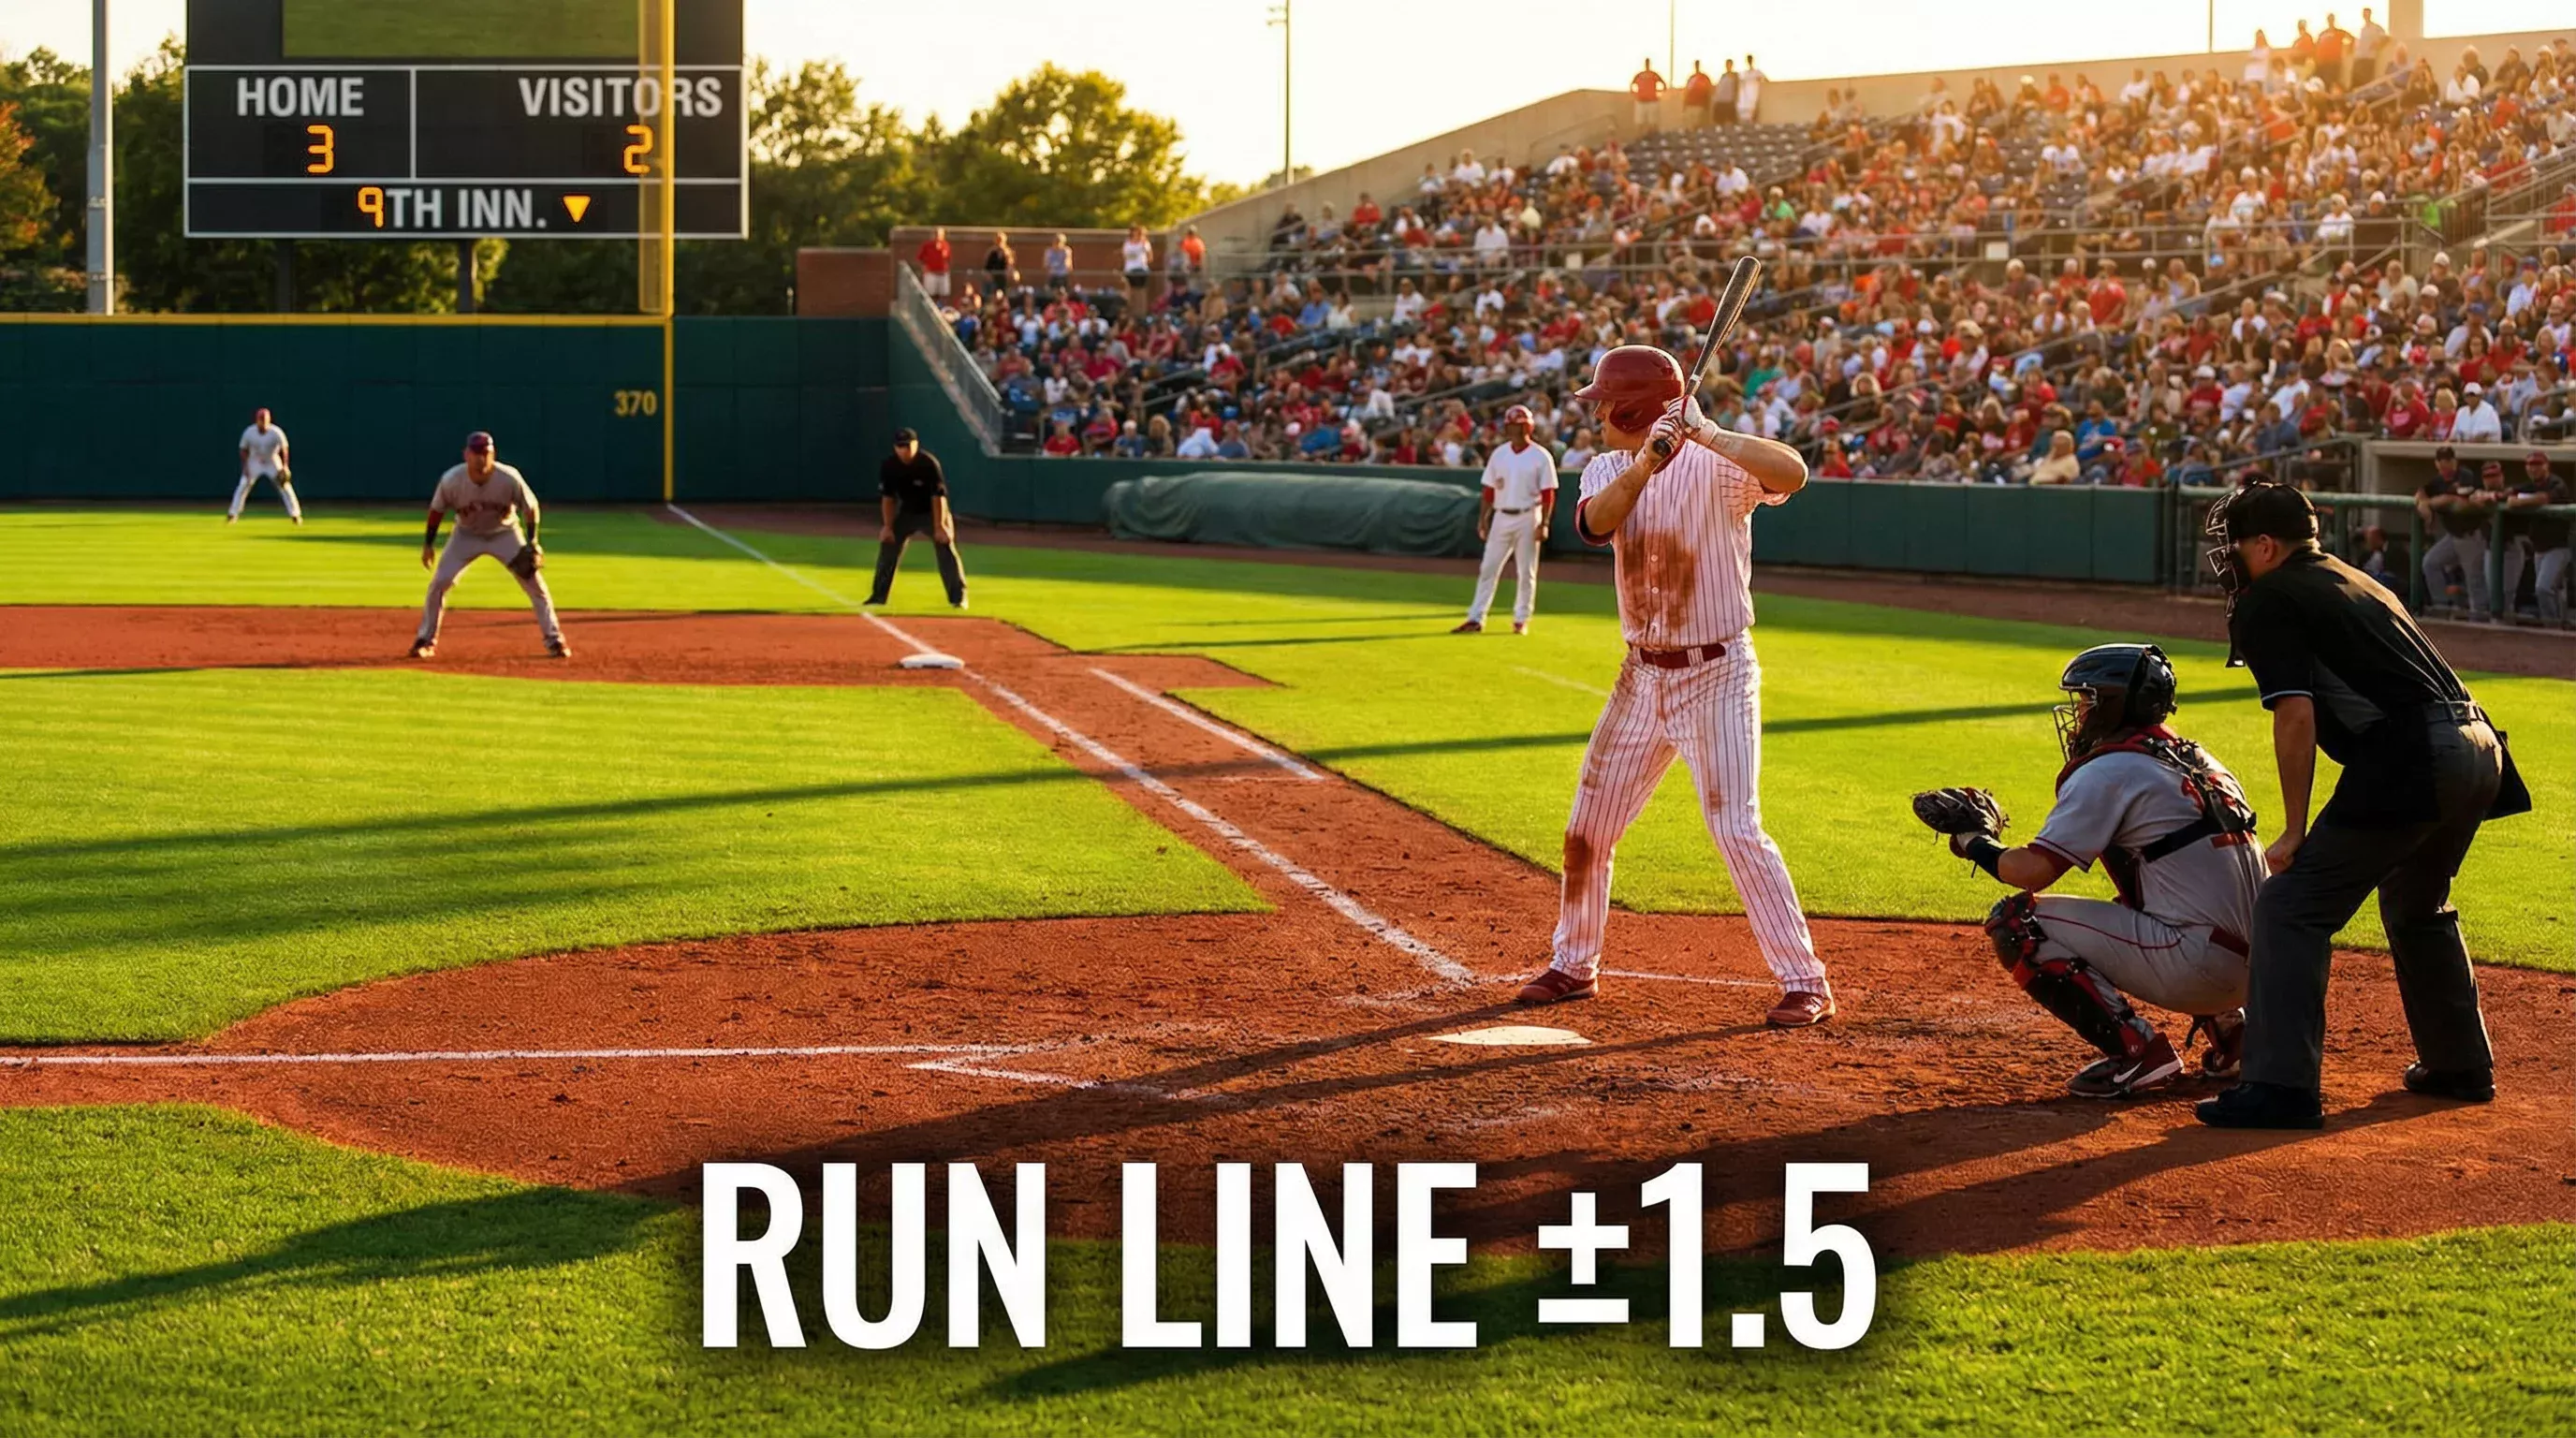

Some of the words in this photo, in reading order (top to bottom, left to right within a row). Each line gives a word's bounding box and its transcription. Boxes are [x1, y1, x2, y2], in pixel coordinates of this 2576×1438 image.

[237, 77, 364, 117] HOME
[518, 76, 724, 118] VISITORS
[306, 125, 335, 174] 3
[622, 124, 654, 175] 2
[357, 186, 442, 228] 9TH
[458, 188, 548, 228] INN.
[614, 389, 658, 417] 370
